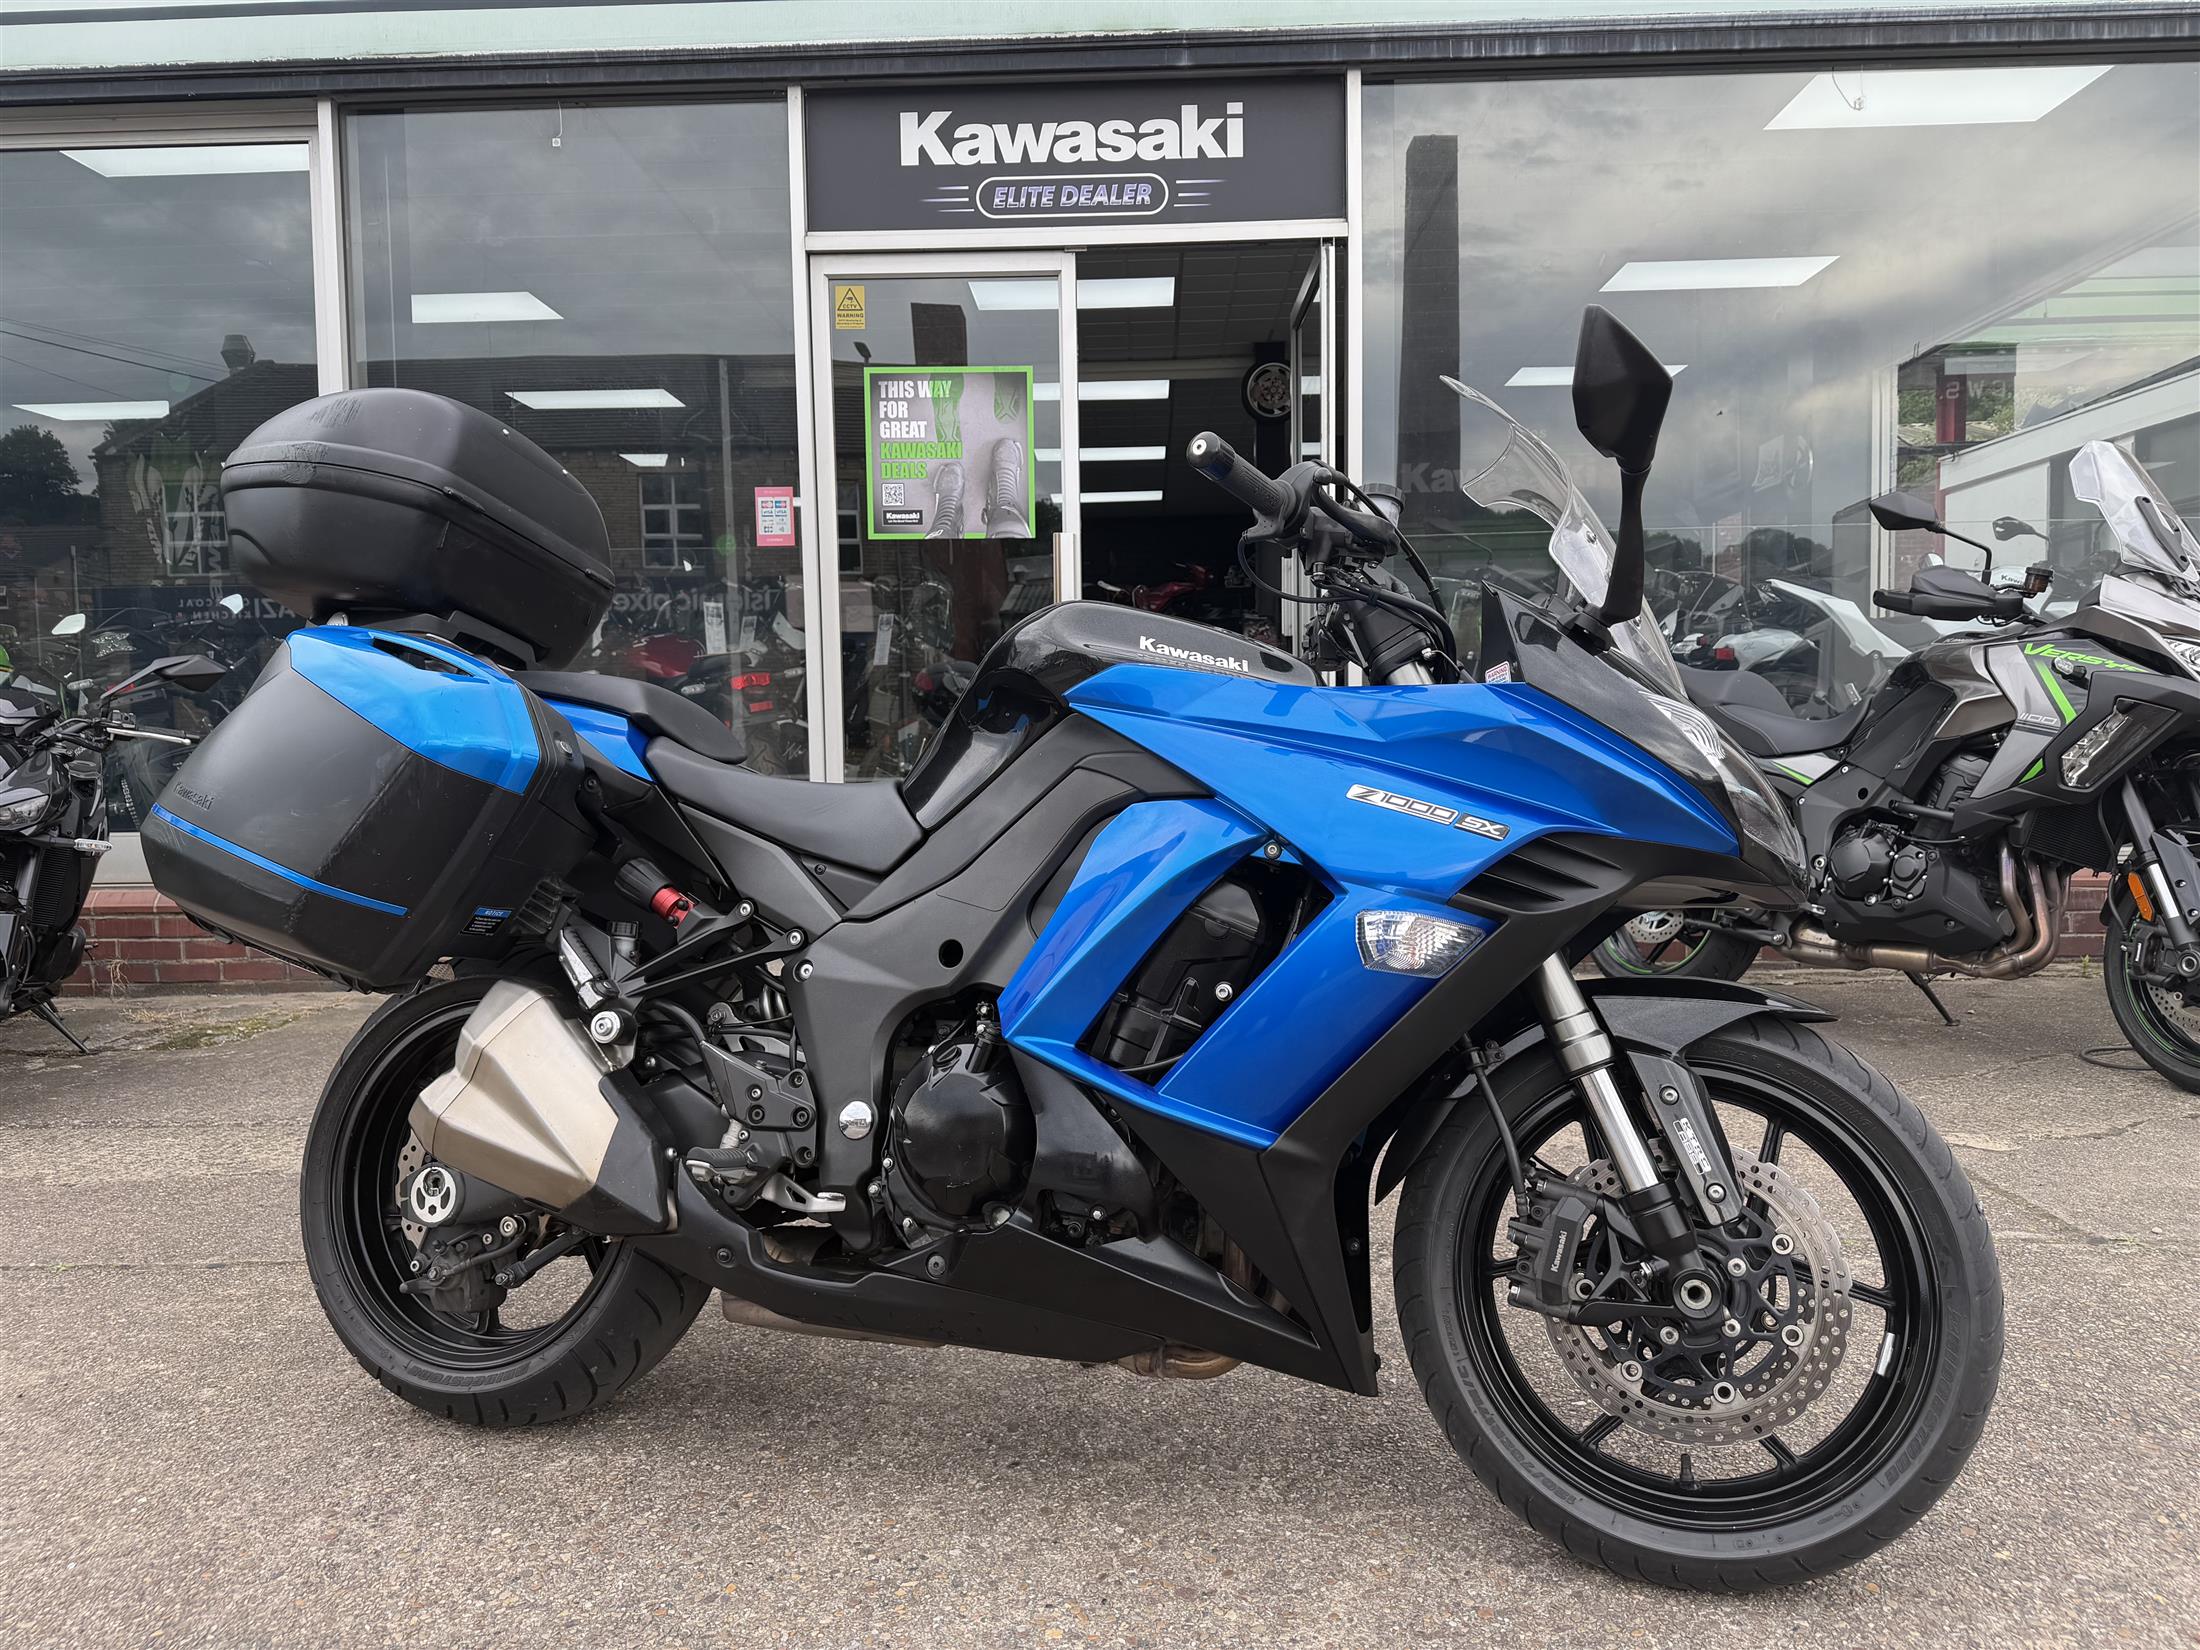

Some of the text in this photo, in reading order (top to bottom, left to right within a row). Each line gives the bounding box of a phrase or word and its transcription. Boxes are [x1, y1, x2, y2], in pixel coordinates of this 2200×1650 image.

[900, 102, 1244, 166] Kawasaki
[993, 183, 1152, 208] ELITE DEALER
[878, 380, 952, 399] THIS WAY
[879, 401, 909, 419] FOR
[880, 421, 928, 439] GREAT
[880, 442, 963, 459] KAWASAKI
[881, 462, 928, 479] DEALS
[886, 512, 920, 520] Kawasaki
[1140, 635, 1249, 673] Kawasaki
[2020, 712, 2058, 724] 1100
[173, 782, 215, 810] Kawasaki
[1353, 786, 1505, 836] Z1000 SX
[1550, 1230, 1568, 1273] Kawasaki
